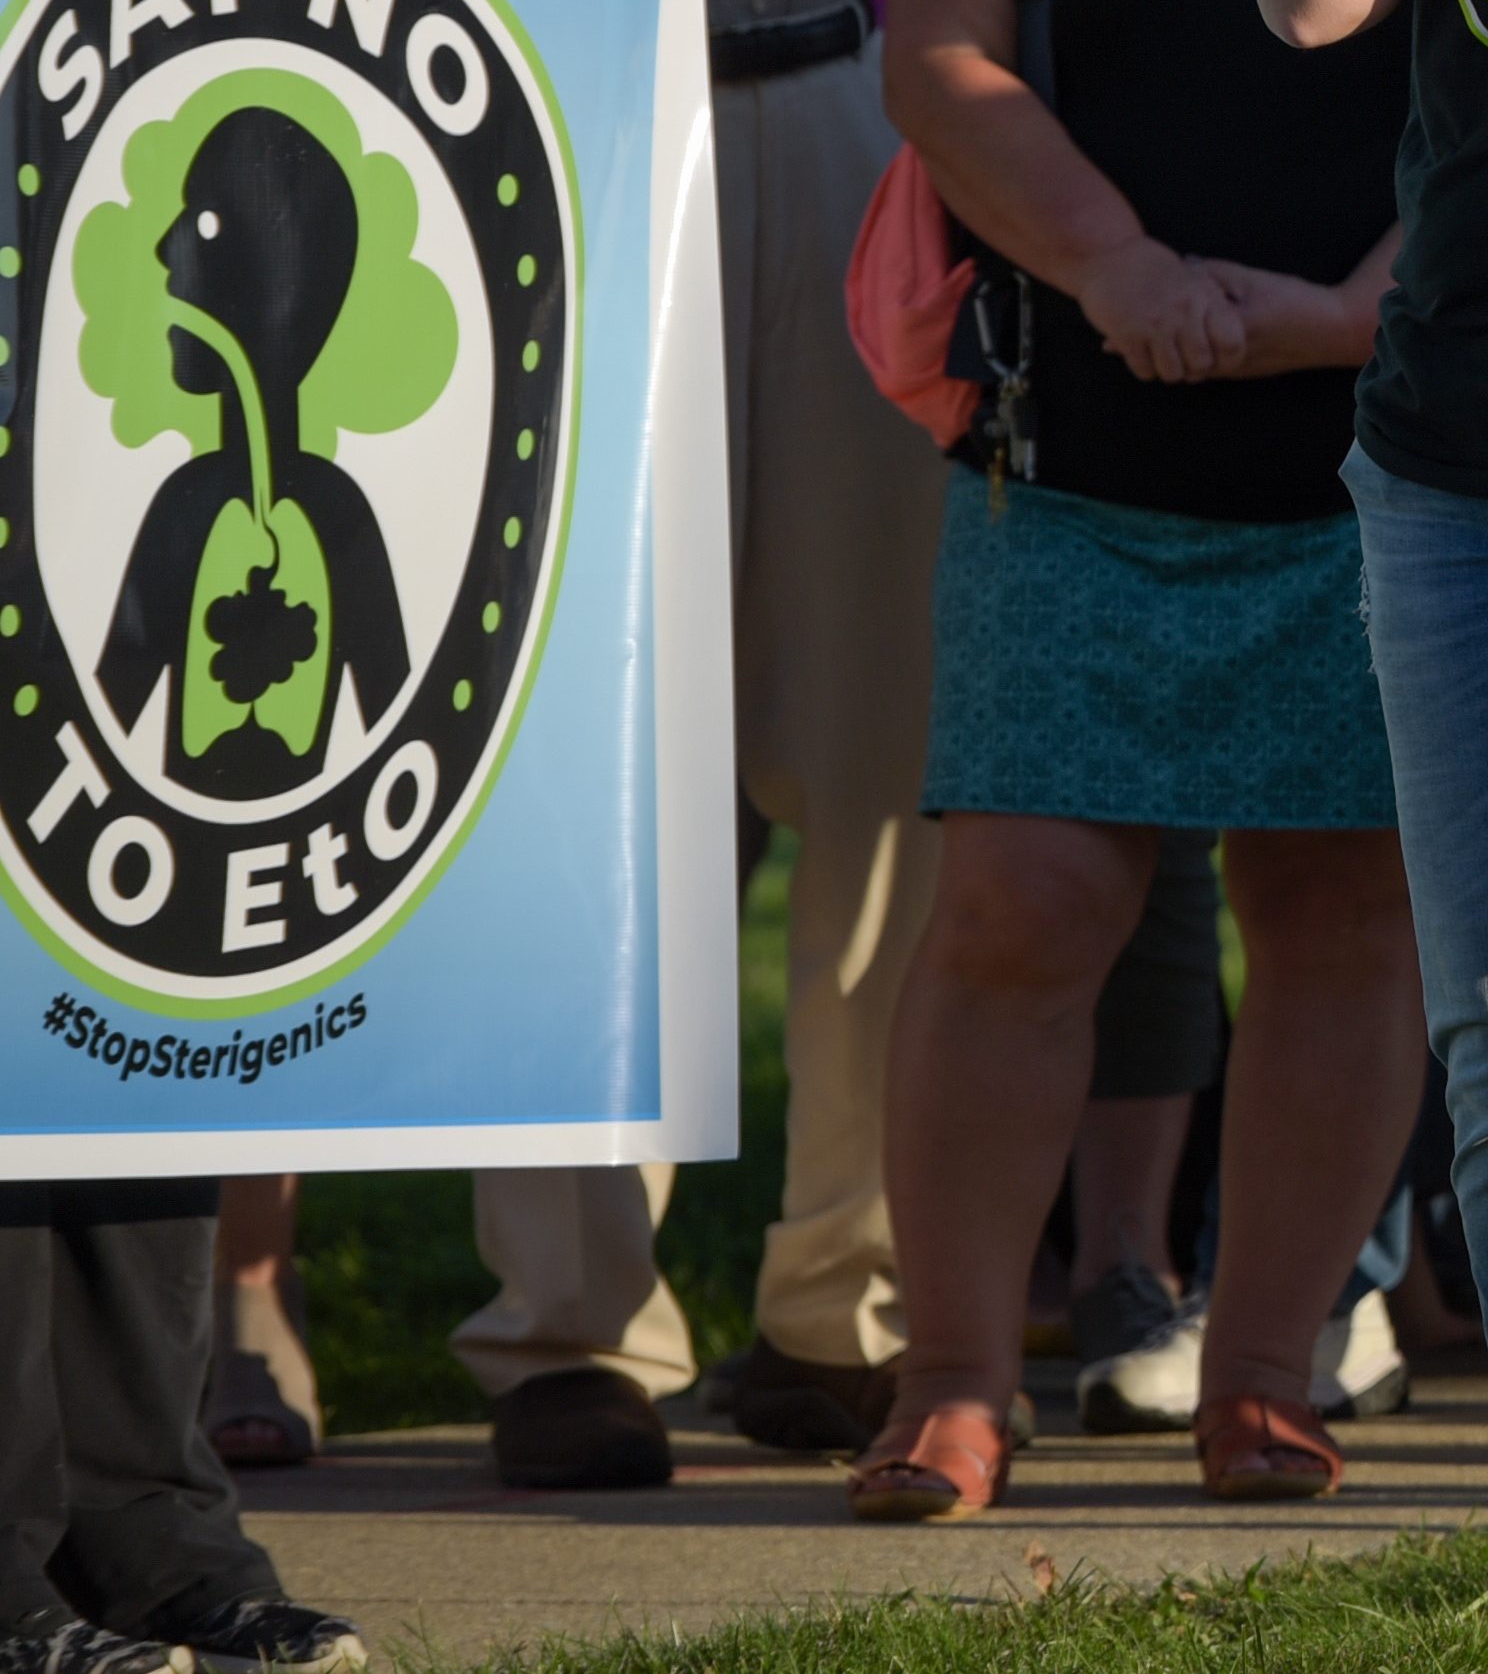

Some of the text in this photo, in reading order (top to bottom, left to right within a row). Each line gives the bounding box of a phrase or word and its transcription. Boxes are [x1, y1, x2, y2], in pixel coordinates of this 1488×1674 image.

[26, 721, 439, 955] TO EtO
[41, 991, 368, 1084] #StopSterigenics
